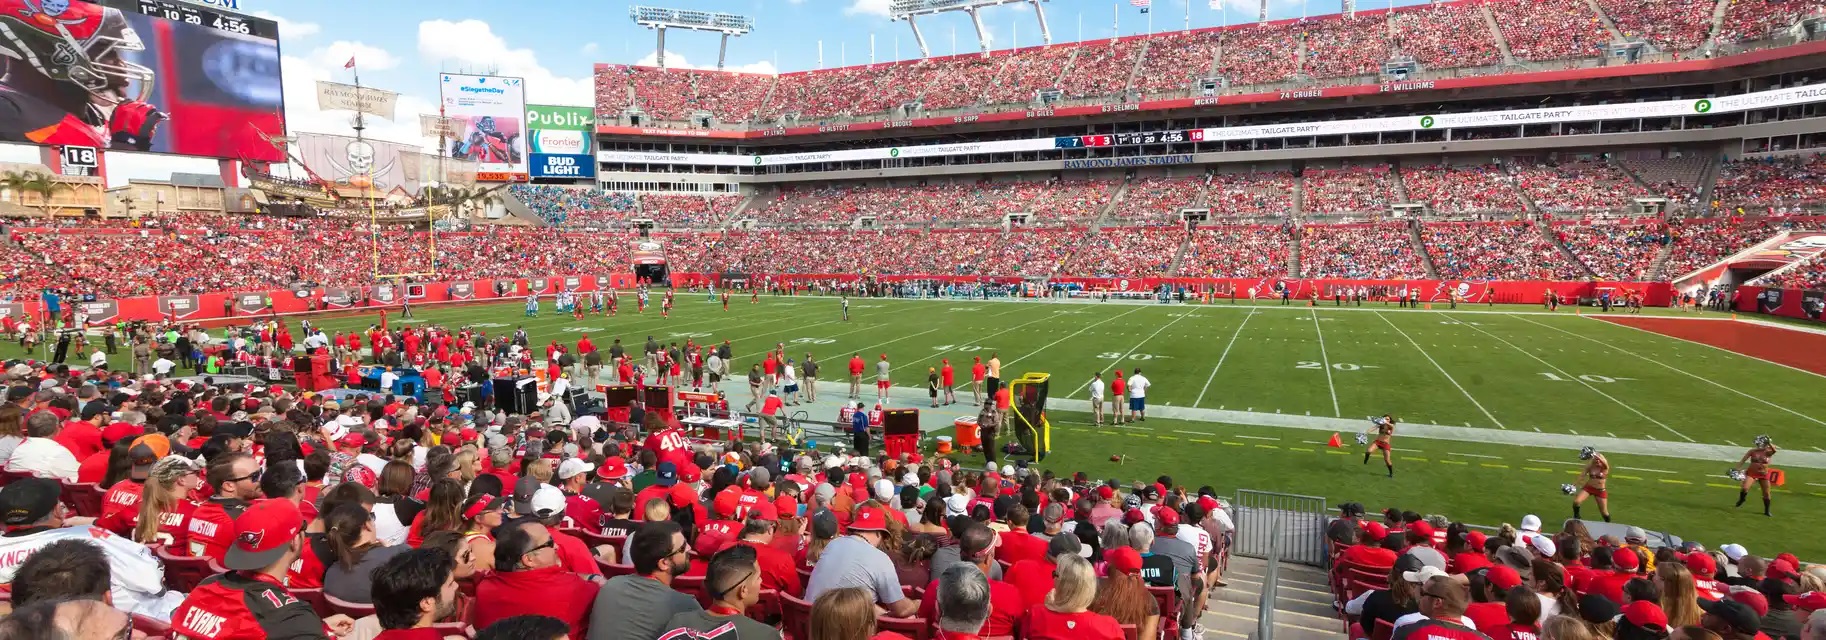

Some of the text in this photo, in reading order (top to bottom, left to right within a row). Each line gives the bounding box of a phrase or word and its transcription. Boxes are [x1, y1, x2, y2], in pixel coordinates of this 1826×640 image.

[164, 10, 180, 20] 10
[184, 14, 202, 25] 20
[212, 18, 250, 34] 4:56
[1393, 81, 1434, 91] WILLIAMS
[1741, 92, 1792, 106] ULTIMATE
[528, 110, 588, 126] Publix
[1500, 112, 1542, 121] TAILGATE
[1544, 110, 1572, 118] PARTY
[542, 136, 581, 146] Frontier
[1160, 134, 1183, 142] 4:56
[1192, 132, 1202, 140] 18
[1072, 138, 1078, 146] 7
[1103, 137, 1110, 146] 3
[70, 148, 94, 163] 18
[548, 156, 575, 166] BUD
[1064, 155, 1194, 168] RAYMOND JAMES STADIUM
[543, 165, 580, 175] LIGHT
[1096, 352, 1152, 360] 30
[1295, 361, 1360, 371] 20
[1536, 372, 1616, 382] 10
[660, 432, 683, 452] 40
[110, 489, 138, 506] LYNCH
[182, 606, 228, 638] EVANS
